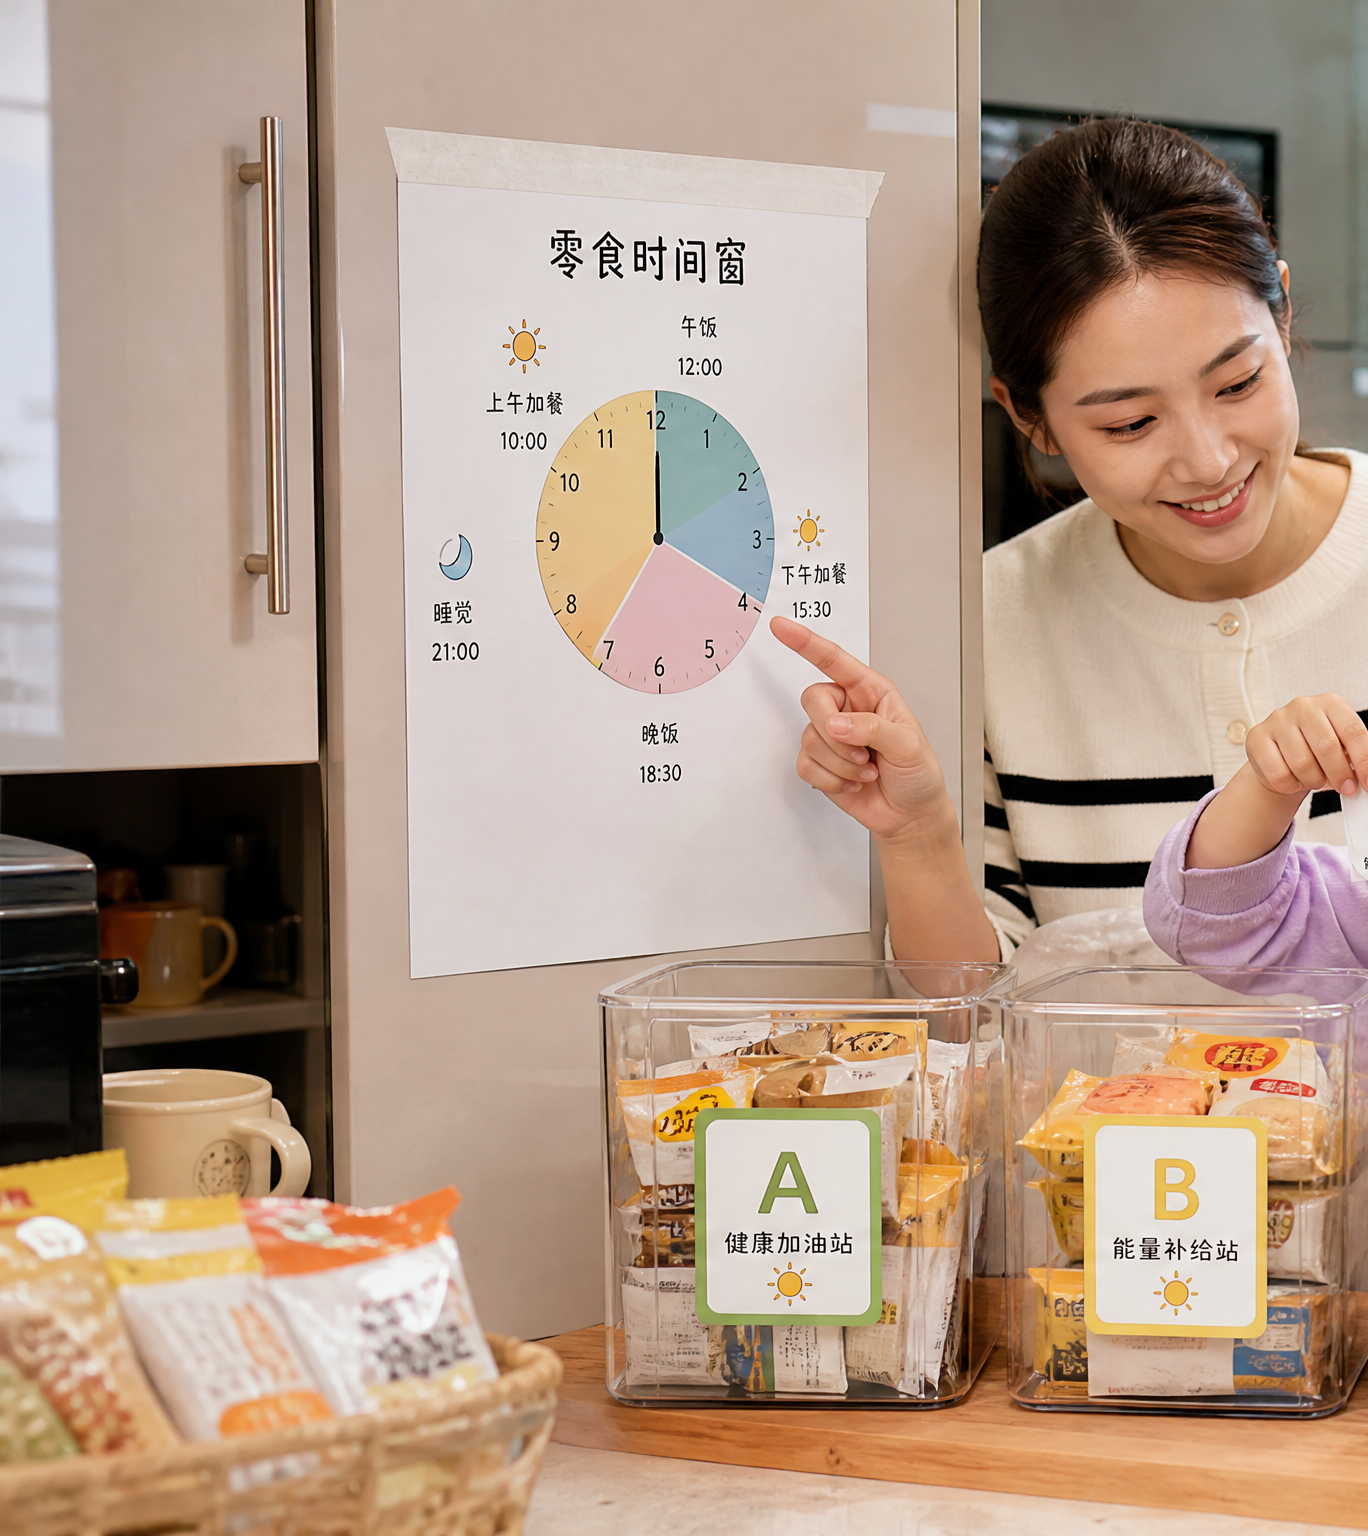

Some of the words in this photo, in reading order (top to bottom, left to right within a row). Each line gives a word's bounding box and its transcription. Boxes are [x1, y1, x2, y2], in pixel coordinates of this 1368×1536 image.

[549, 228, 747, 286] 零食时间窗
[681, 314, 718, 339] 午饭
[677, 357, 723, 377] 12:00
[486, 391, 564, 416] 上午加餐
[646, 409, 667, 431] 12
[500, 431, 548, 451] 10:00
[597, 428, 613, 449] 11
[703, 428, 710, 449] 1
[559, 472, 580, 493] 10
[737, 472, 748, 492] 2
[549, 530, 560, 552] 9
[752, 529, 762, 550] 3
[780, 562, 847, 586] 下午加餐
[433, 600, 473, 625] 睡觉
[566, 593, 577, 615] 8
[737, 591, 749, 612] 4
[792, 600, 832, 619] 15:30
[431, 641, 480, 662] 21:00
[602, 639, 615, 661] 7
[704, 639, 715, 659] 5
[654, 656, 665, 678] 6
[641, 722, 679, 746] 晚饭
[639, 763, 682, 784] 18:30
[757, 1150, 819, 1215] A
[1153, 1157, 1201, 1221] B
[724, 1230, 854, 1255] 健康加油站
[1112, 1236, 1239, 1263] 能量补给站
